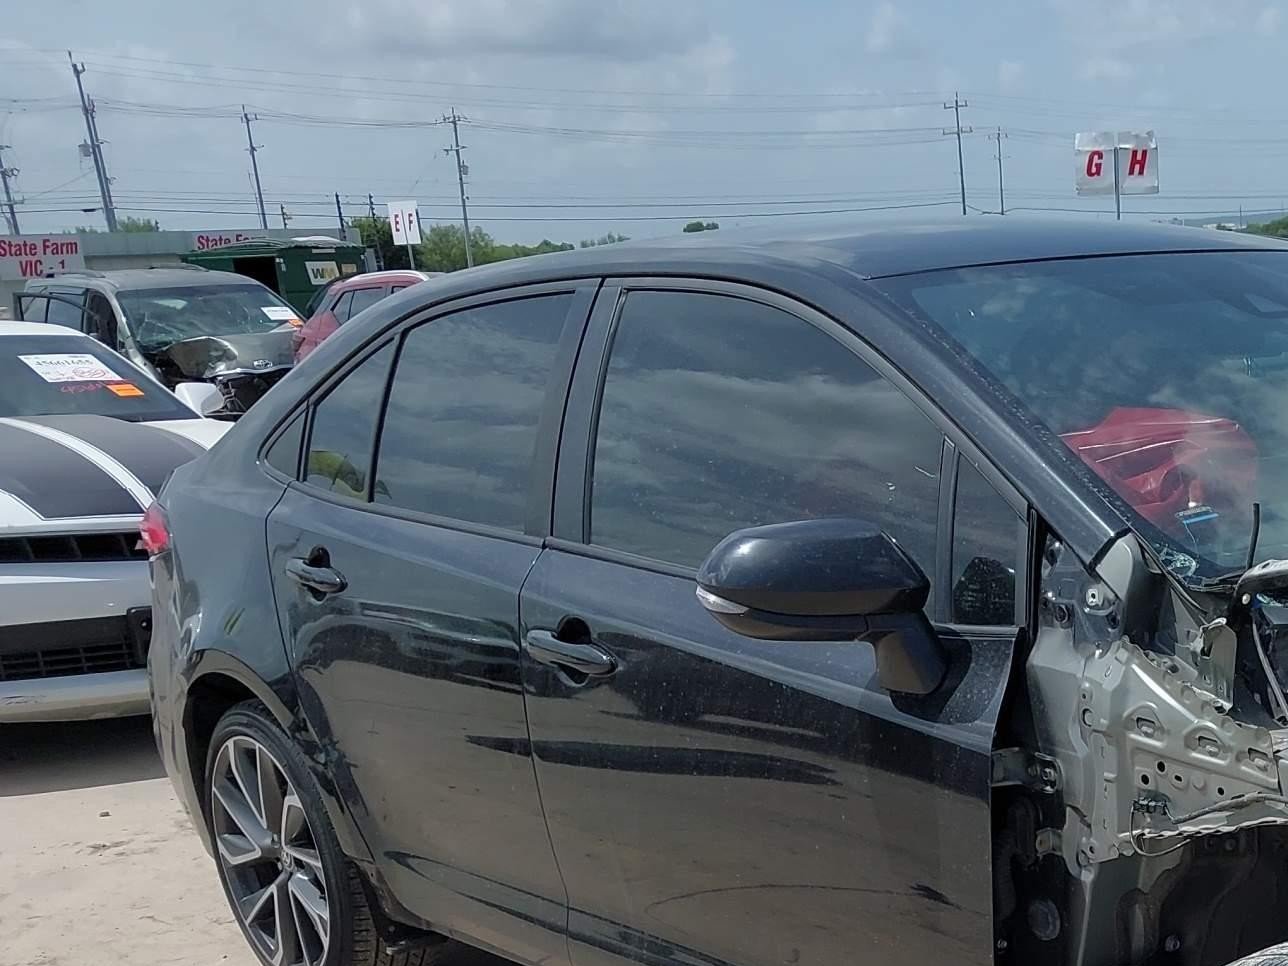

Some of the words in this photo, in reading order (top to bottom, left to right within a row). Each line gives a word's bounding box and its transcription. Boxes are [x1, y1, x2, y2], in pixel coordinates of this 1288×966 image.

[1086, 150, 1104, 177] G
[1128, 149, 1148, 176] H
[394, 213, 401, 232] E
[408, 212, 414, 232] F
[0, 239, 38, 257] State
[42, 238, 78, 256] Farm
[197, 234, 231, 250] State
[19, 259, 44, 277] VIC
